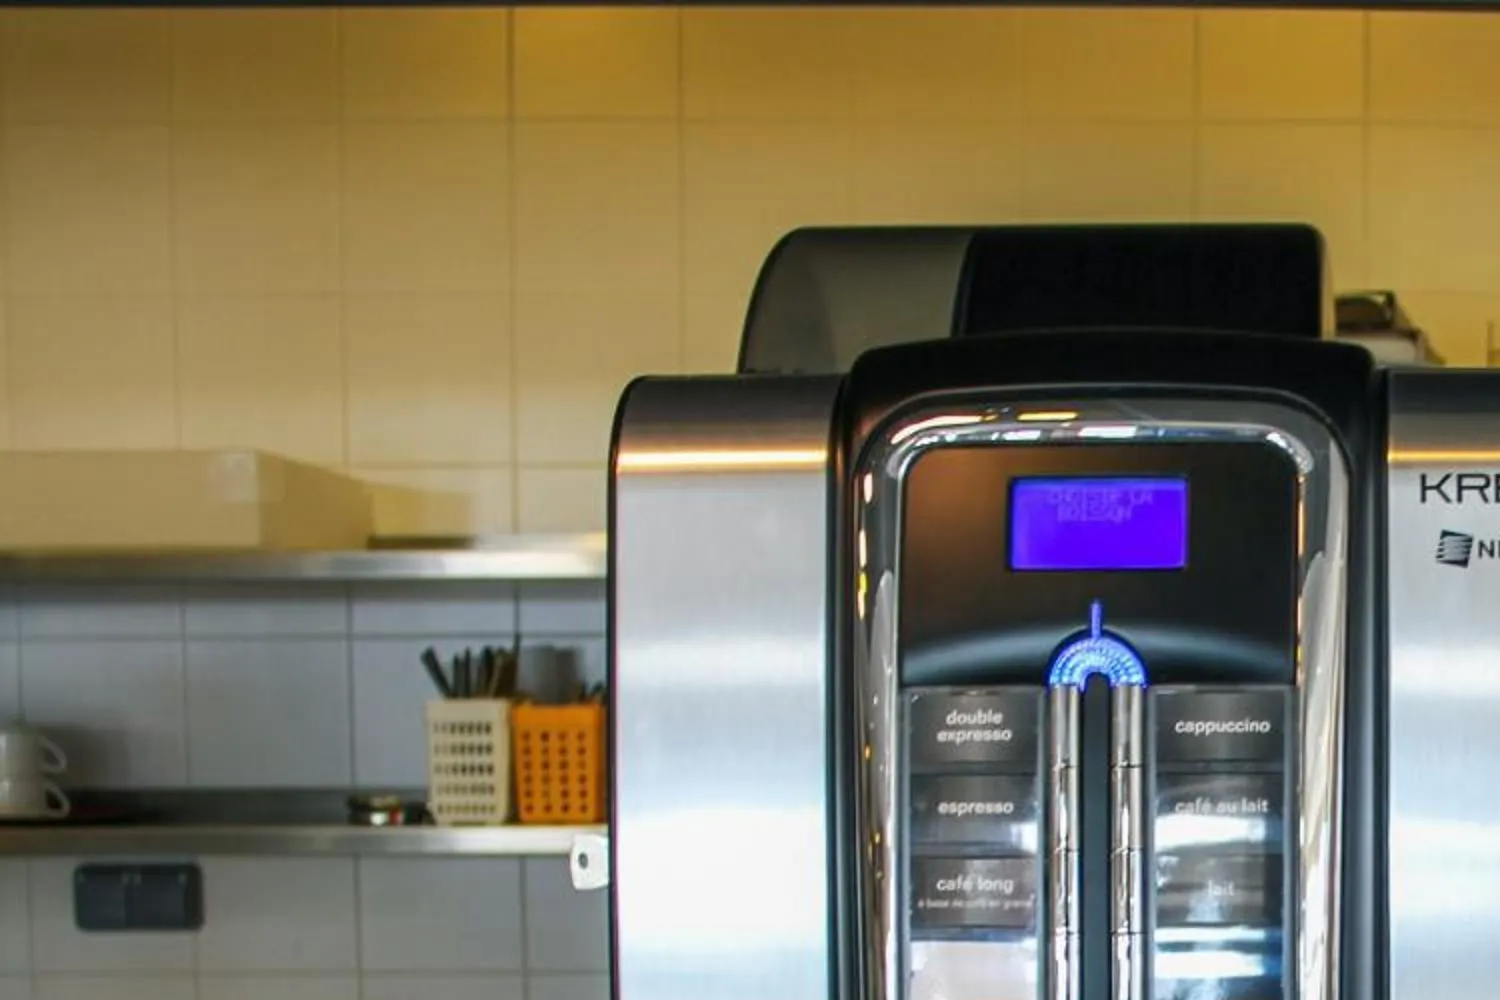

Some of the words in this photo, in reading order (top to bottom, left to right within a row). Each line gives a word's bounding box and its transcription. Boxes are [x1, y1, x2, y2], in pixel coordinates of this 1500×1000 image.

[945, 708, 1003, 725] double
[1175, 718, 1271, 736] cappuccino
[937, 729, 1012, 745] expresso
[938, 801, 1014, 817] espresso
[1175, 797, 1211, 815] café
[1216, 803, 1237, 814] au
[1241, 797, 1269, 813] lait
[936, 874, 973, 892] café
[977, 875, 1014, 895] long
